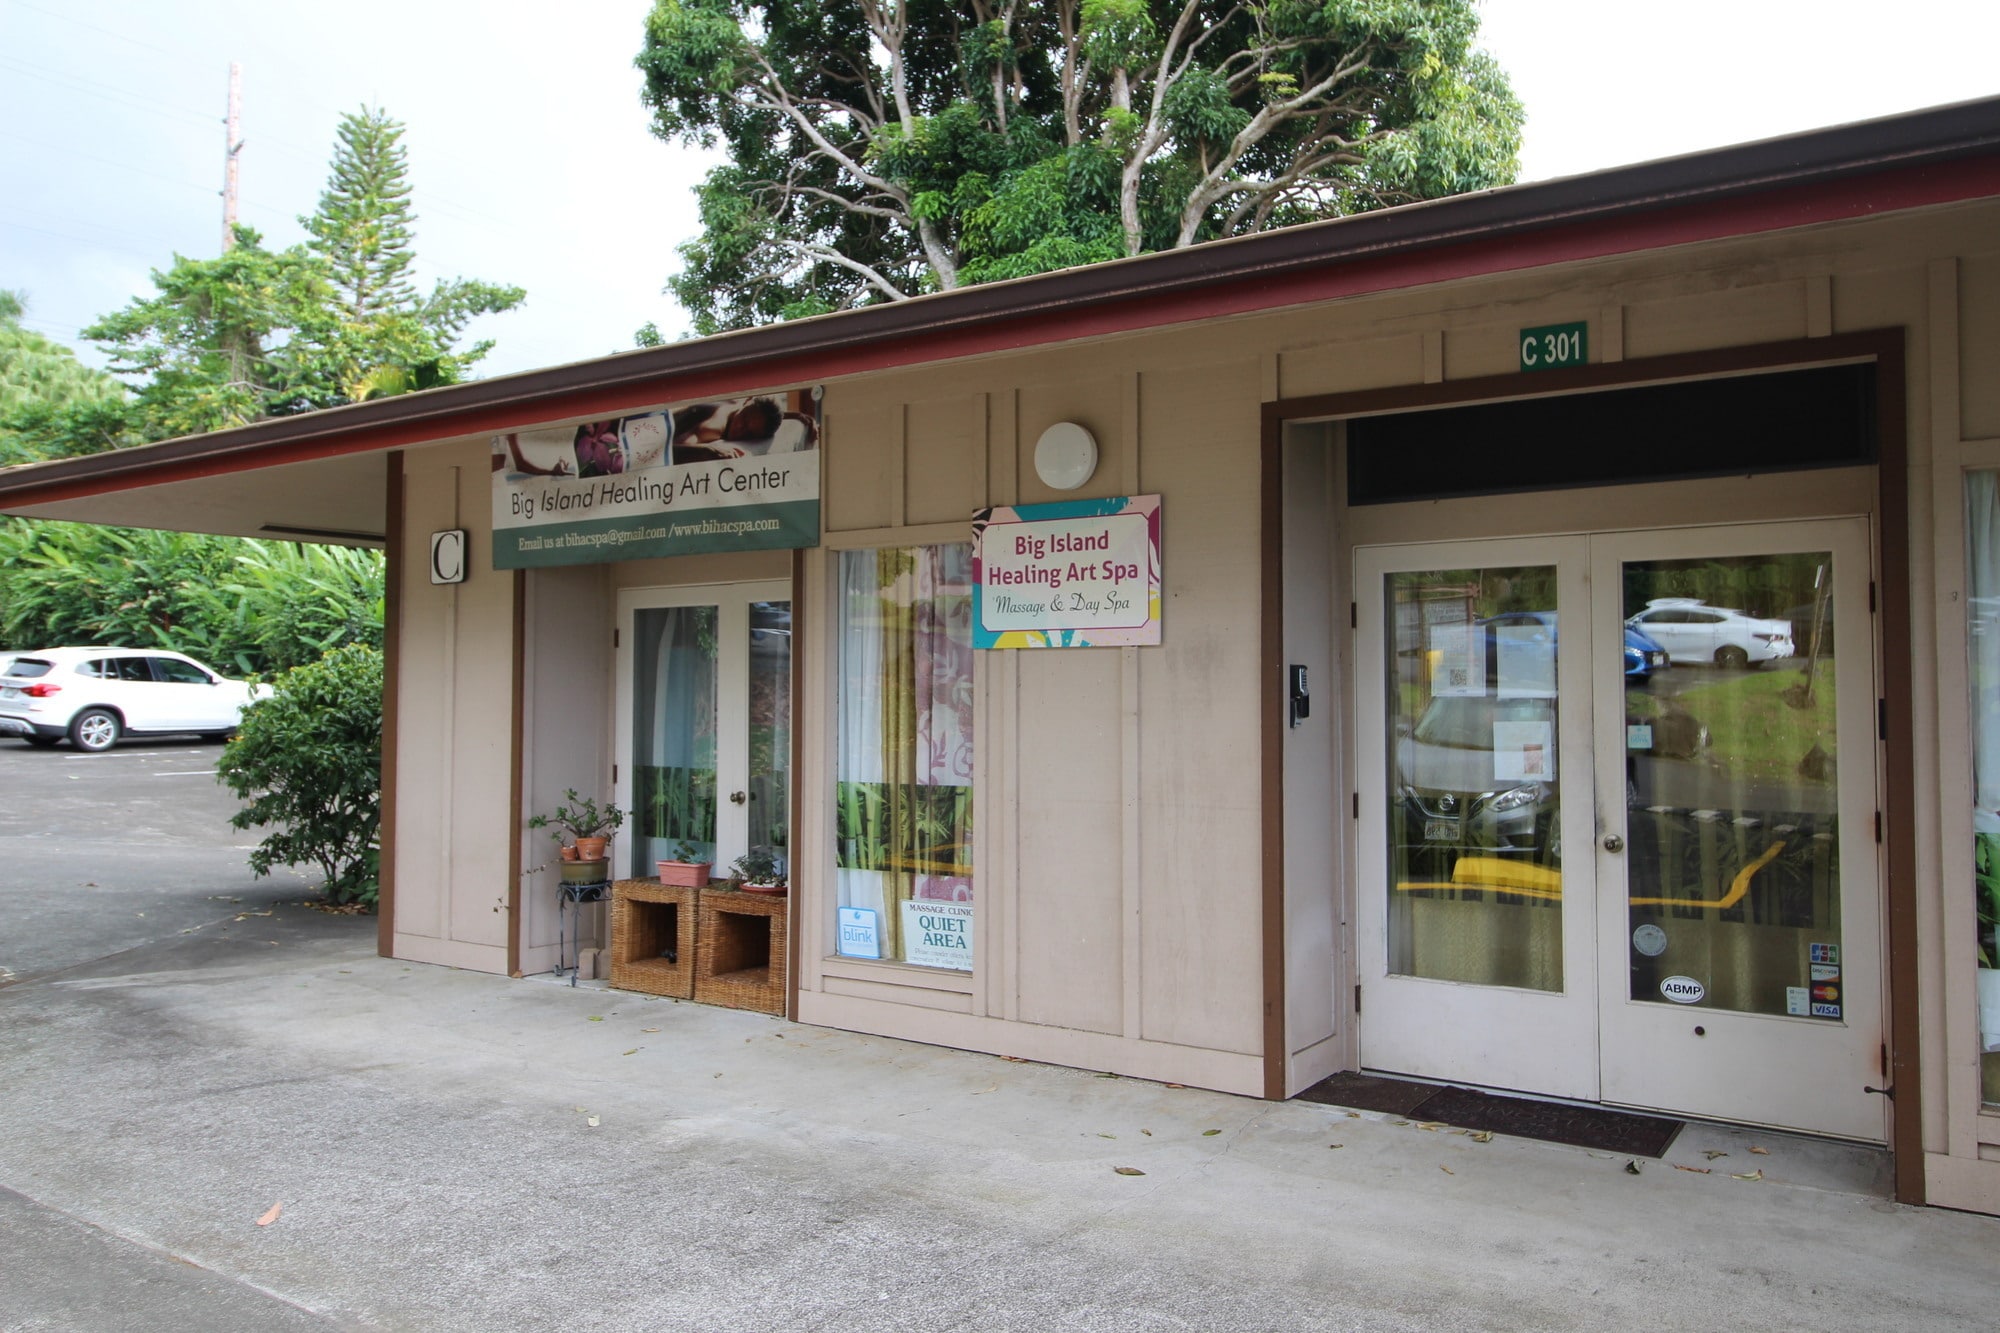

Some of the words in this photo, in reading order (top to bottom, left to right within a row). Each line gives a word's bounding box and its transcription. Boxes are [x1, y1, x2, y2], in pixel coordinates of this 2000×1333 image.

[1522, 336, 1538, 366] C
[1544, 330, 1580, 363] 301
[511, 492, 535, 519] Big
[540, 483, 596, 512] Island
[599, 475, 674, 505] Healing
[679, 471, 711, 497] Art
[717, 466, 791, 493] Center
[518, 535, 543, 551] Email
[544, 539, 555, 549] us
[556, 537, 565, 548] at
[565, 526, 667, 549] bihacspa@gmail.com
[1014, 534, 1046, 560] Big
[1050, 529, 1110, 553] Island
[433, 532, 460, 581] C
[988, 564, 1063, 589] Healing
[1066, 561, 1097, 582] Art
[1101, 560, 1139, 586] Spa
[993, 594, 1046, 618] Massage
[1049, 593, 1065, 612] &
[1069, 592, 1100, 616] Day
[1103, 590, 1131, 615] Spa
[909, 903, 945, 915] MASSAGE
[843, 927, 873, 944] blink
[918, 915, 966, 933] QUIET
[922, 932, 967, 949] AREA
[1664, 983, 1701, 995] ABMP
[1815, 1005, 1839, 1015] VISA
